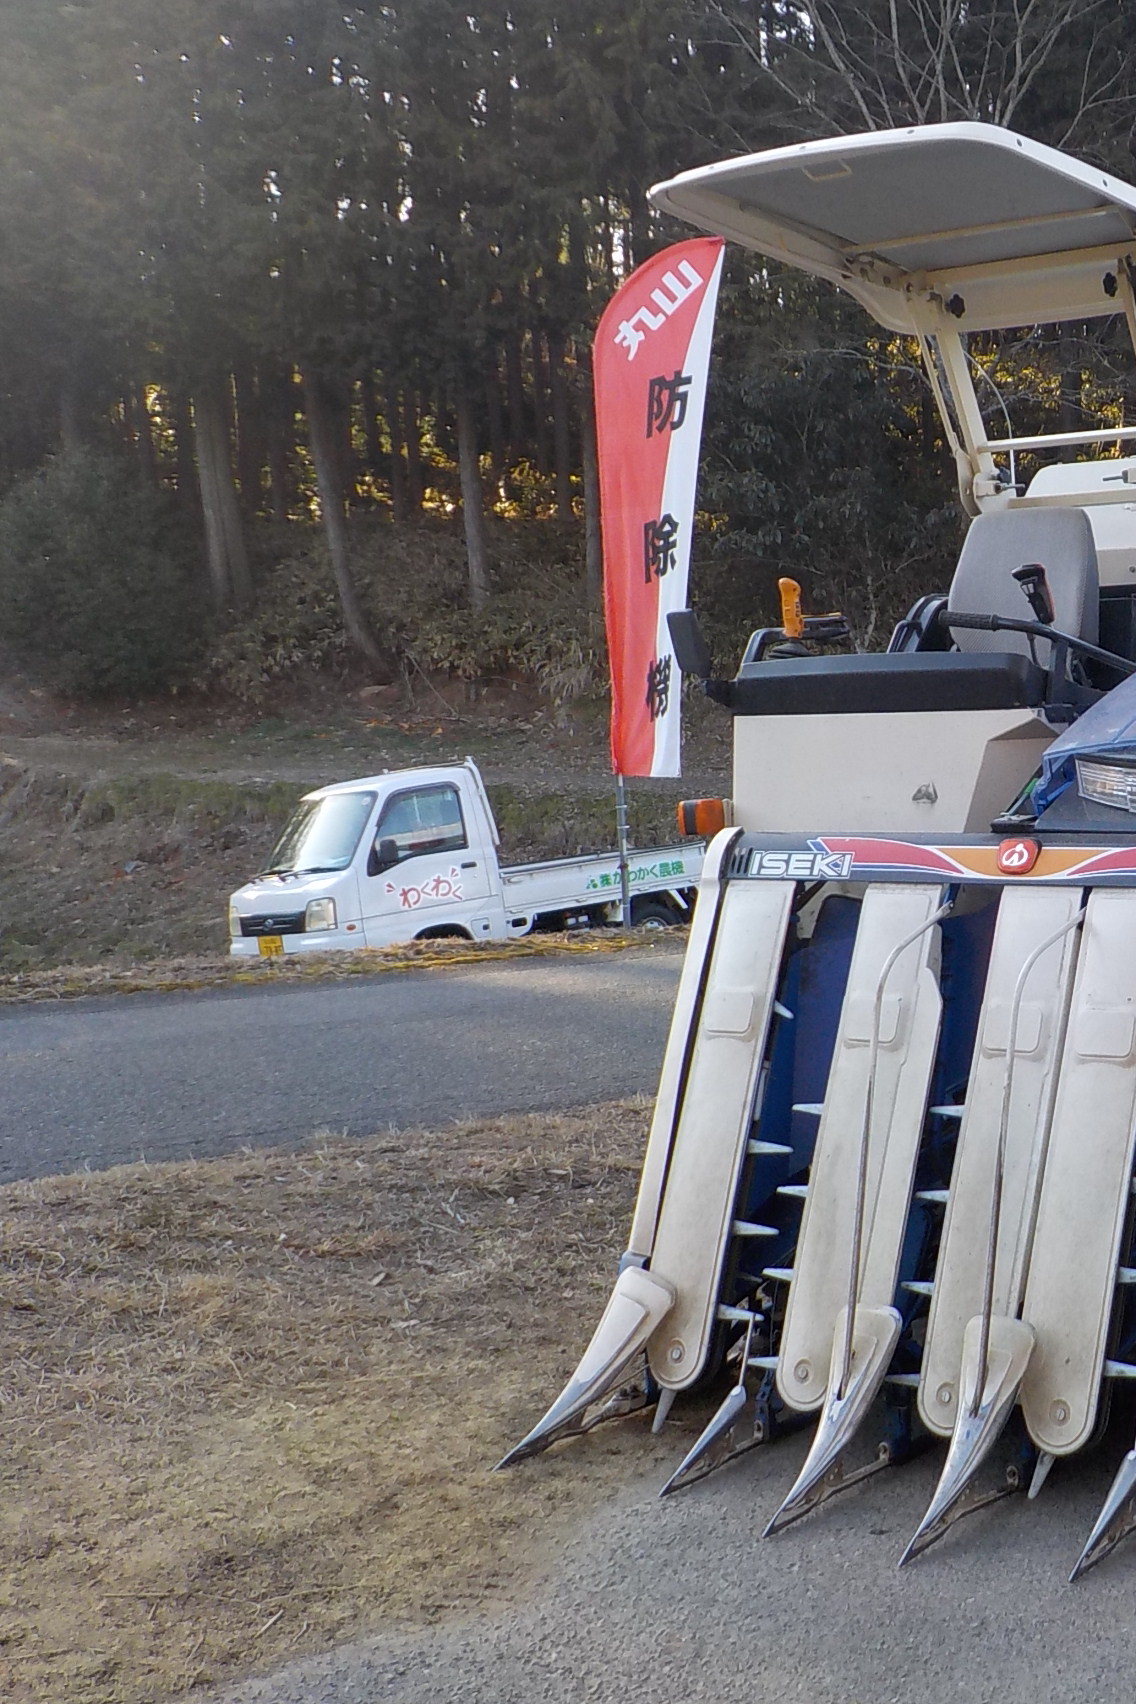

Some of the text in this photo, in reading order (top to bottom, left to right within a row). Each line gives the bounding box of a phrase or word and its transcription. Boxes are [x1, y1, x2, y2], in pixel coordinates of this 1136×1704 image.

[614, 259, 704, 361] 丸山
[643, 370, 693, 723] 防除機
[399, 875, 463, 909] わくわく
[750, 852, 853, 877] ISEKI
